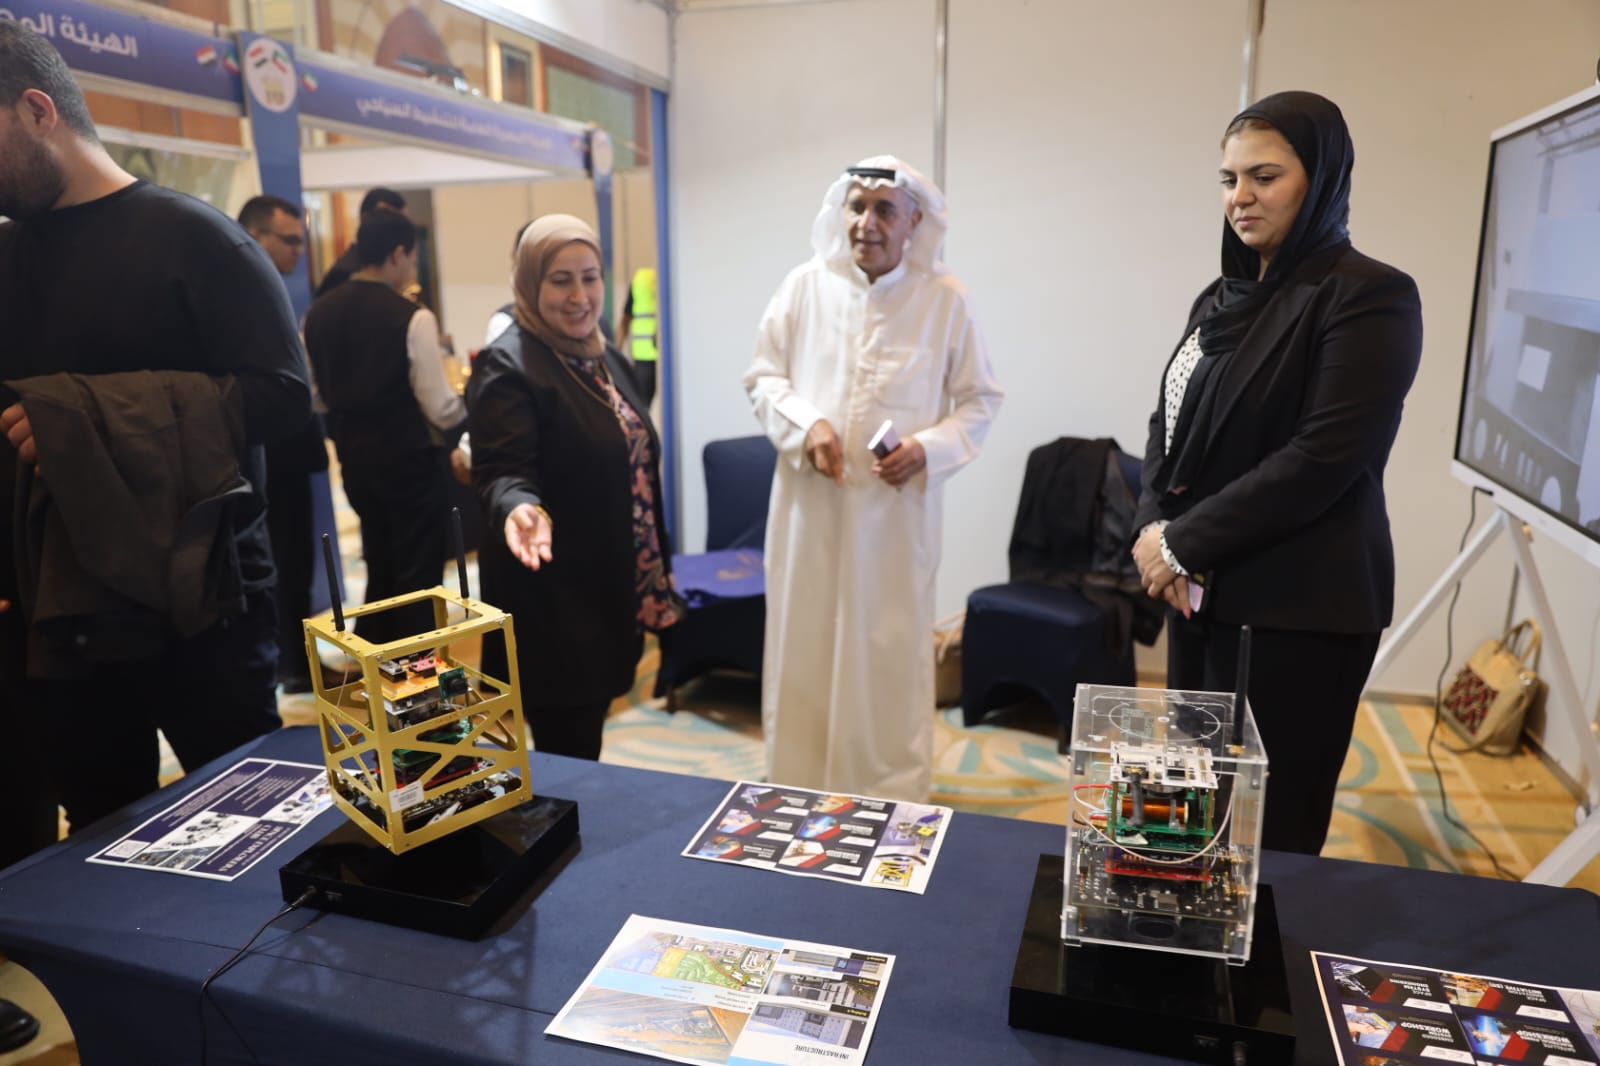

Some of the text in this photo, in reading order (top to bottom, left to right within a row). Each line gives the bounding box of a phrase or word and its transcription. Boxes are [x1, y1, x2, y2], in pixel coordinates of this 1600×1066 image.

[60, 14, 138, 58] الهيئة
[1402, 984, 1431, 993] SYSTEM
[1412, 989, 1433, 997] SPACE
[1400, 1021, 1452, 1035] WORKSHOP
[1516, 1030, 1571, 1043] WORKSHOP
[796, 1045, 849, 1059] INFRASTRUCTURE
